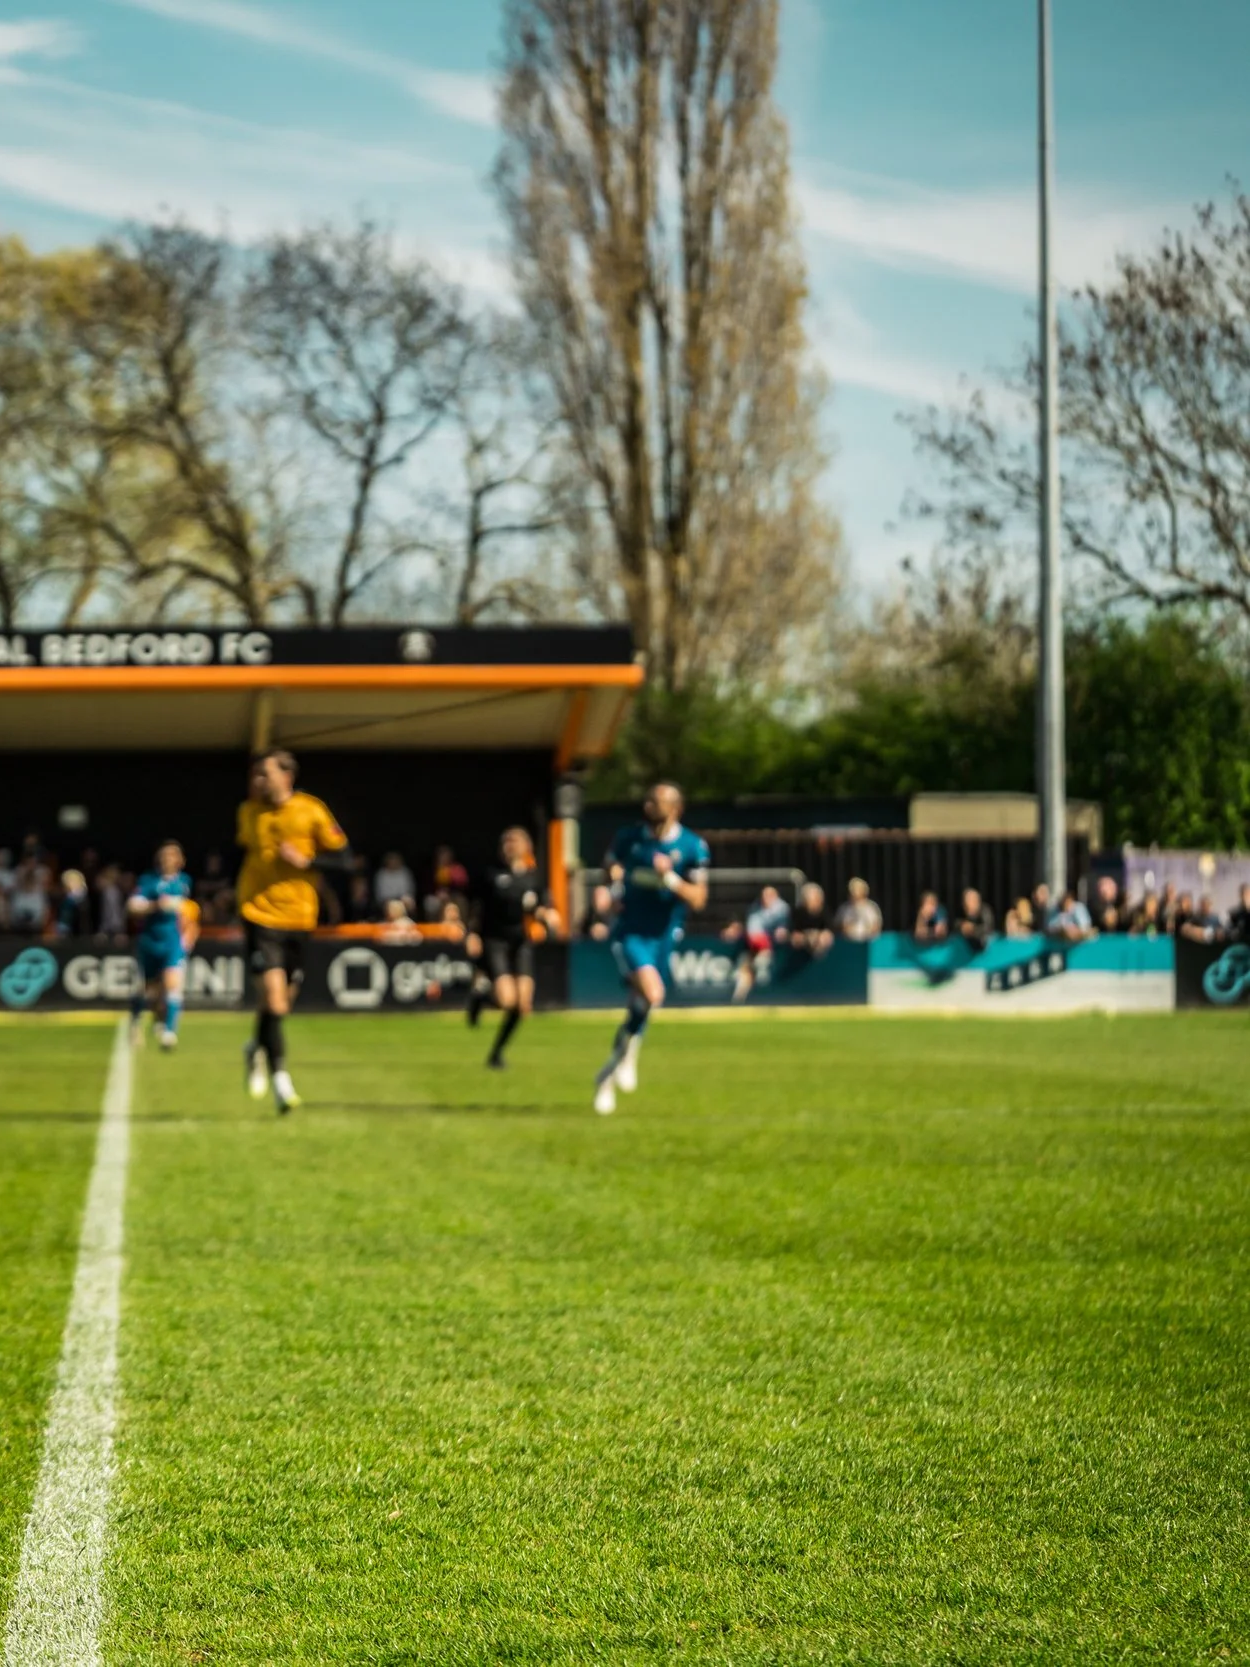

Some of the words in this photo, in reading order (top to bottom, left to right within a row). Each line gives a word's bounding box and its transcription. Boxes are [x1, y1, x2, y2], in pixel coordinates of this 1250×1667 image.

[40, 632, 214, 665] BEDFORD
[219, 632, 273, 664] FC
[62, 954, 246, 999] GEINI
